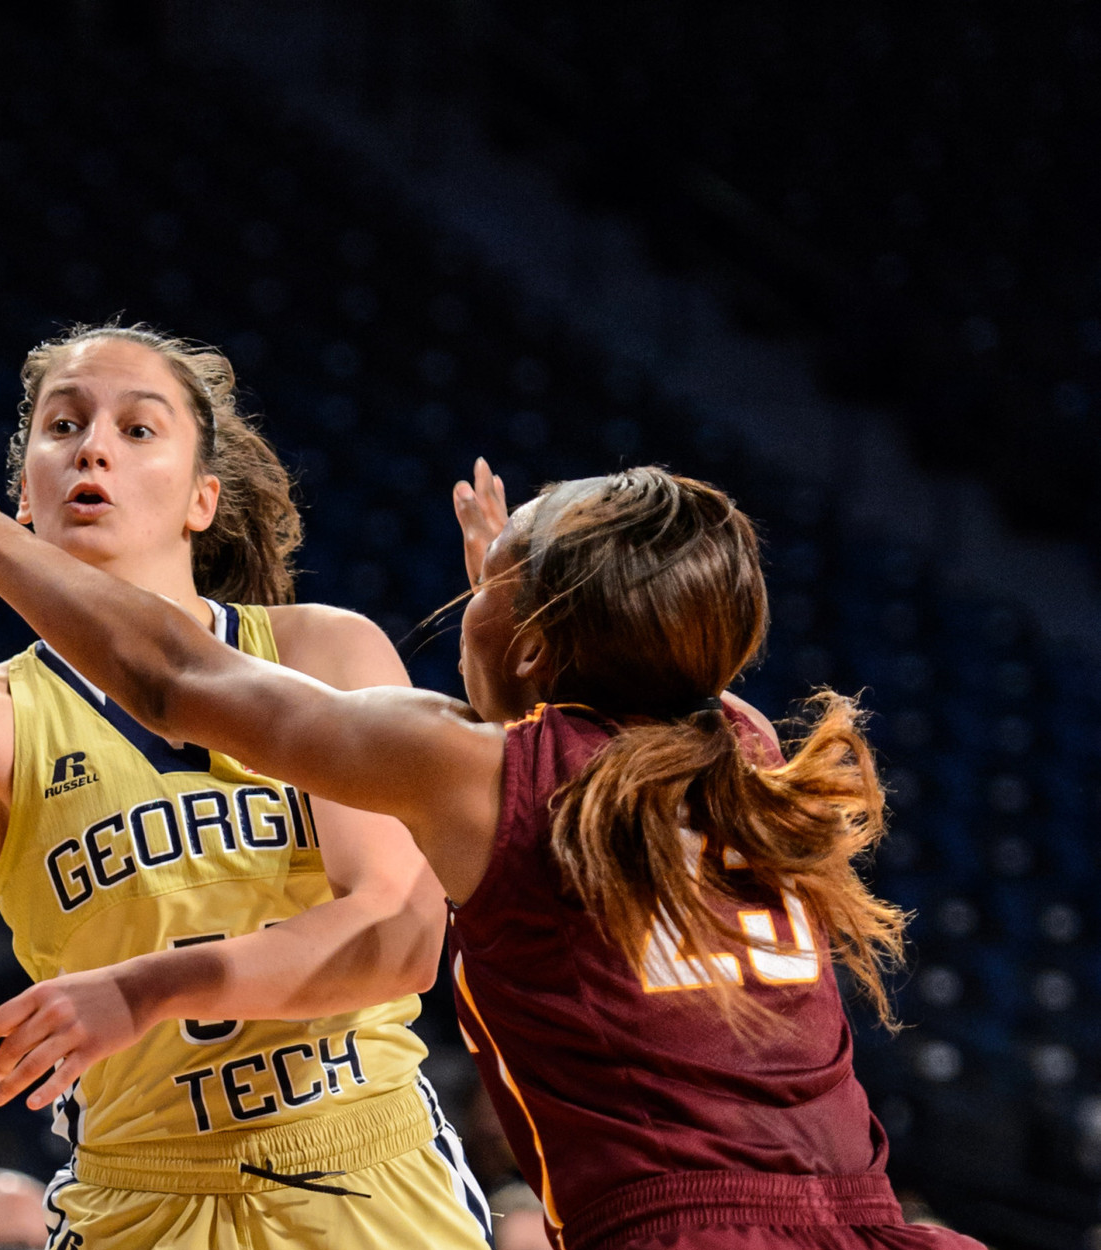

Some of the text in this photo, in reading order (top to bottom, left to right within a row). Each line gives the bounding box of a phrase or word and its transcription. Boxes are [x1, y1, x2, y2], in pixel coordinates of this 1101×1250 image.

[44, 773, 99, 799] RUSSELL
[45, 785, 320, 913] GEORGI
[174, 1029, 368, 1133] TECH
